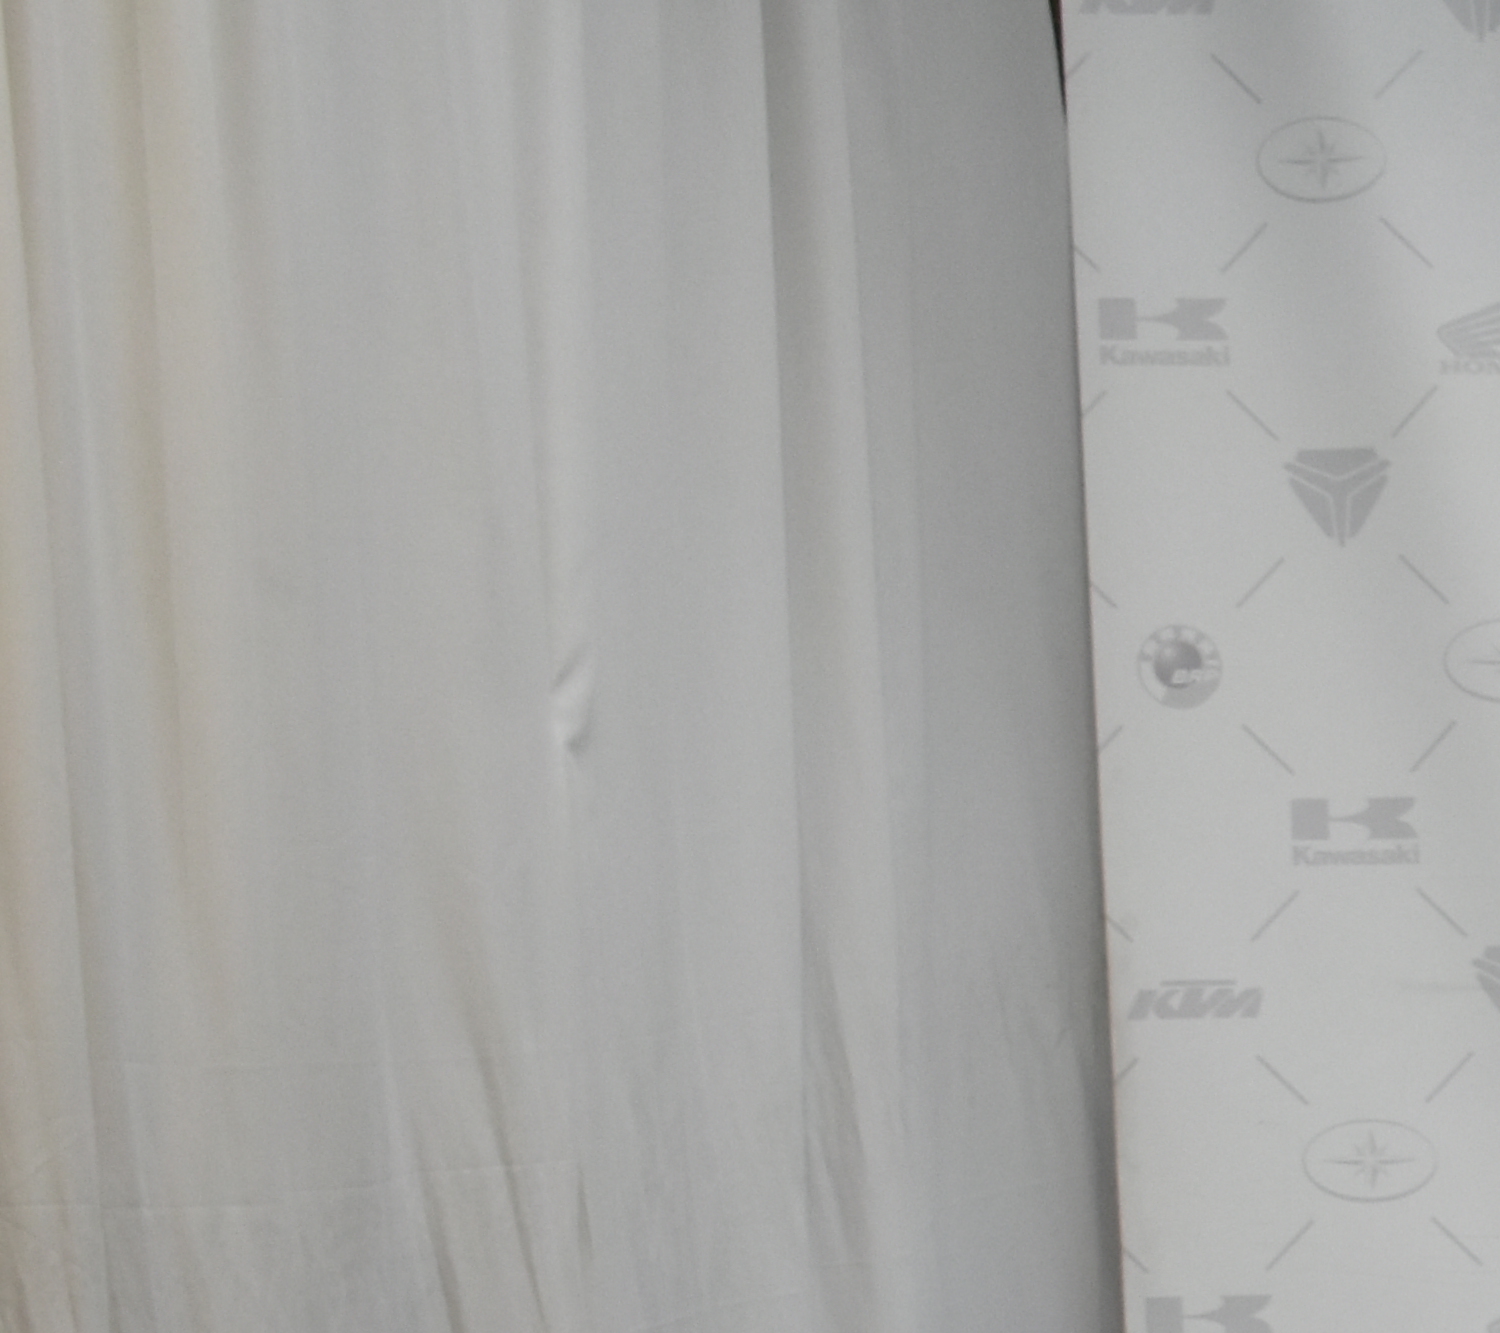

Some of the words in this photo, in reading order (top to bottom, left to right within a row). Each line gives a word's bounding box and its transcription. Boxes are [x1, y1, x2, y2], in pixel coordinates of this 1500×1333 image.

[1098, 343, 1230, 368] Kawasaki
[1169, 668, 1219, 685] BRP
[1291, 841, 1421, 866] Kawasaki
[1128, 979, 1262, 1022] KTM
